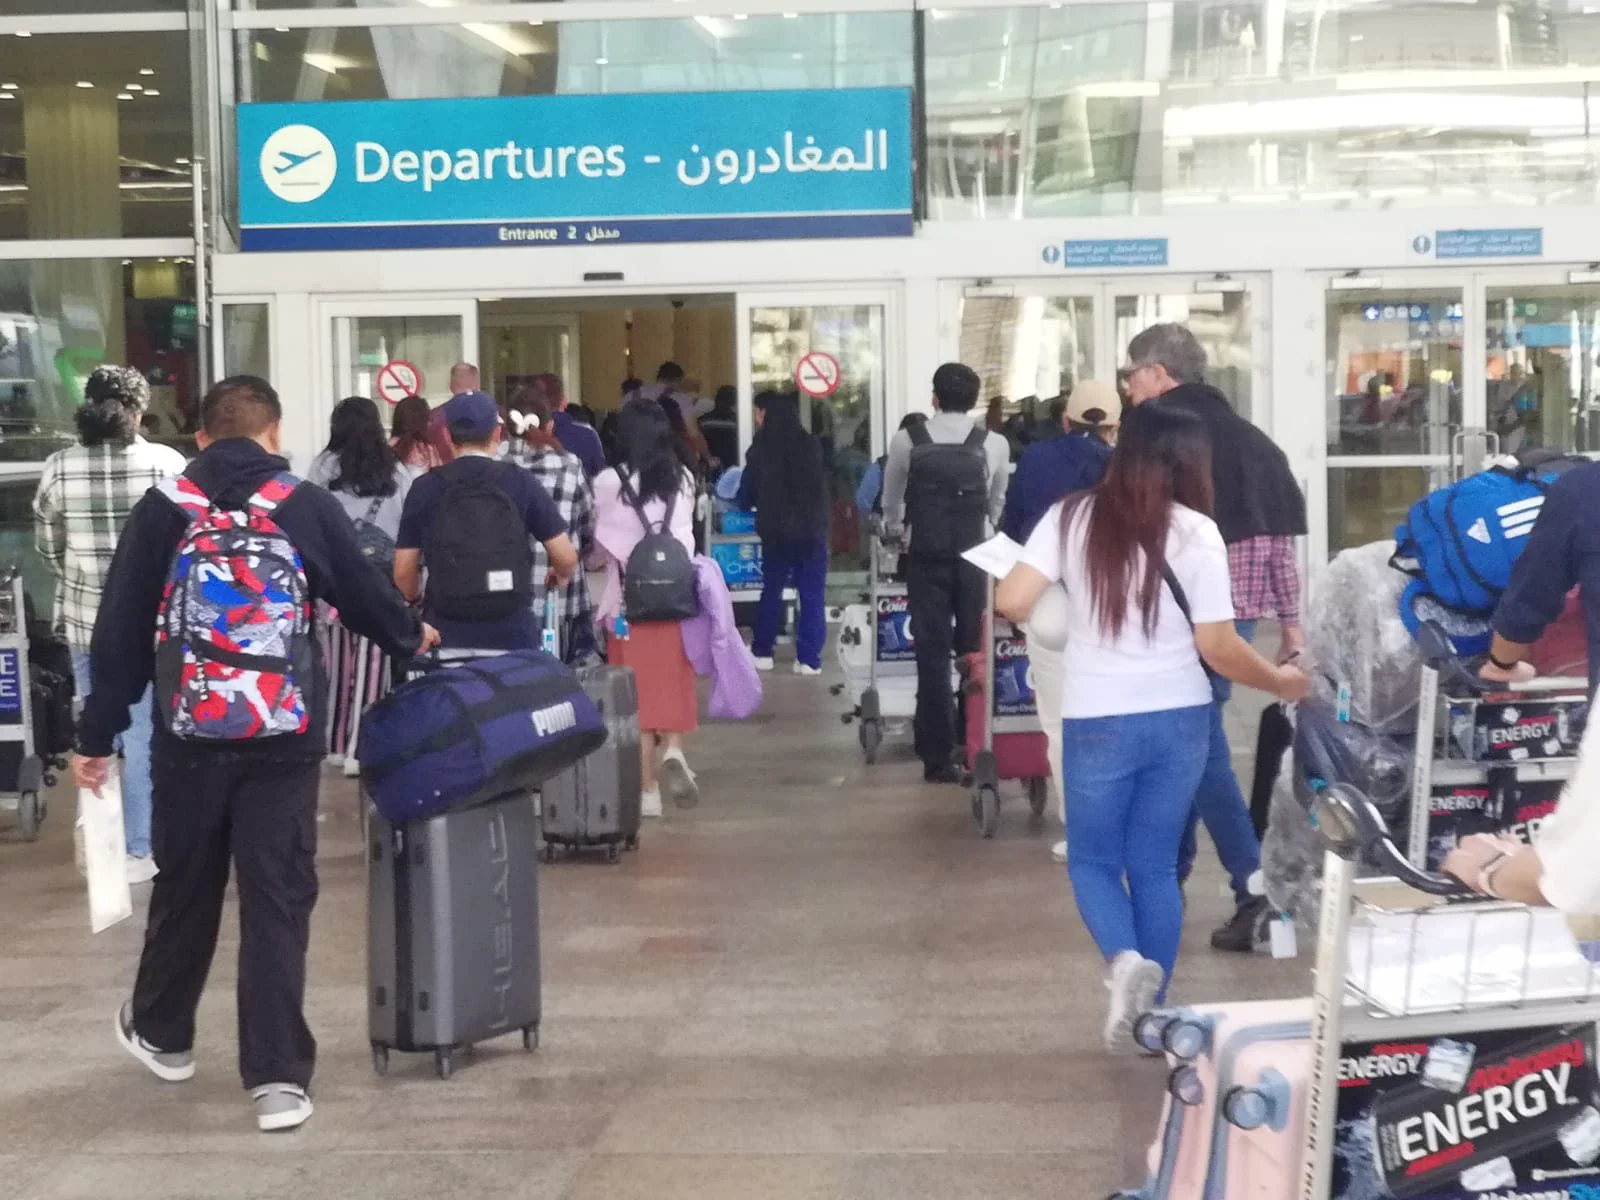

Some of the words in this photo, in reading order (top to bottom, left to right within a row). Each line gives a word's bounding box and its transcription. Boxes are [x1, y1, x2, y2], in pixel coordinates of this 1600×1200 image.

[354, 141, 627, 192] Departures
[677, 127, 890, 188] المغادرون
[498, 226, 558, 241] Entrance
[566, 224, 577, 240] 2
[1491, 721, 1553, 745] ENERGY
[1430, 794, 1487, 813] ENERGY
[1337, 1052, 1423, 1081] ENERGY
[1396, 1061, 1572, 1162] ENERGY
